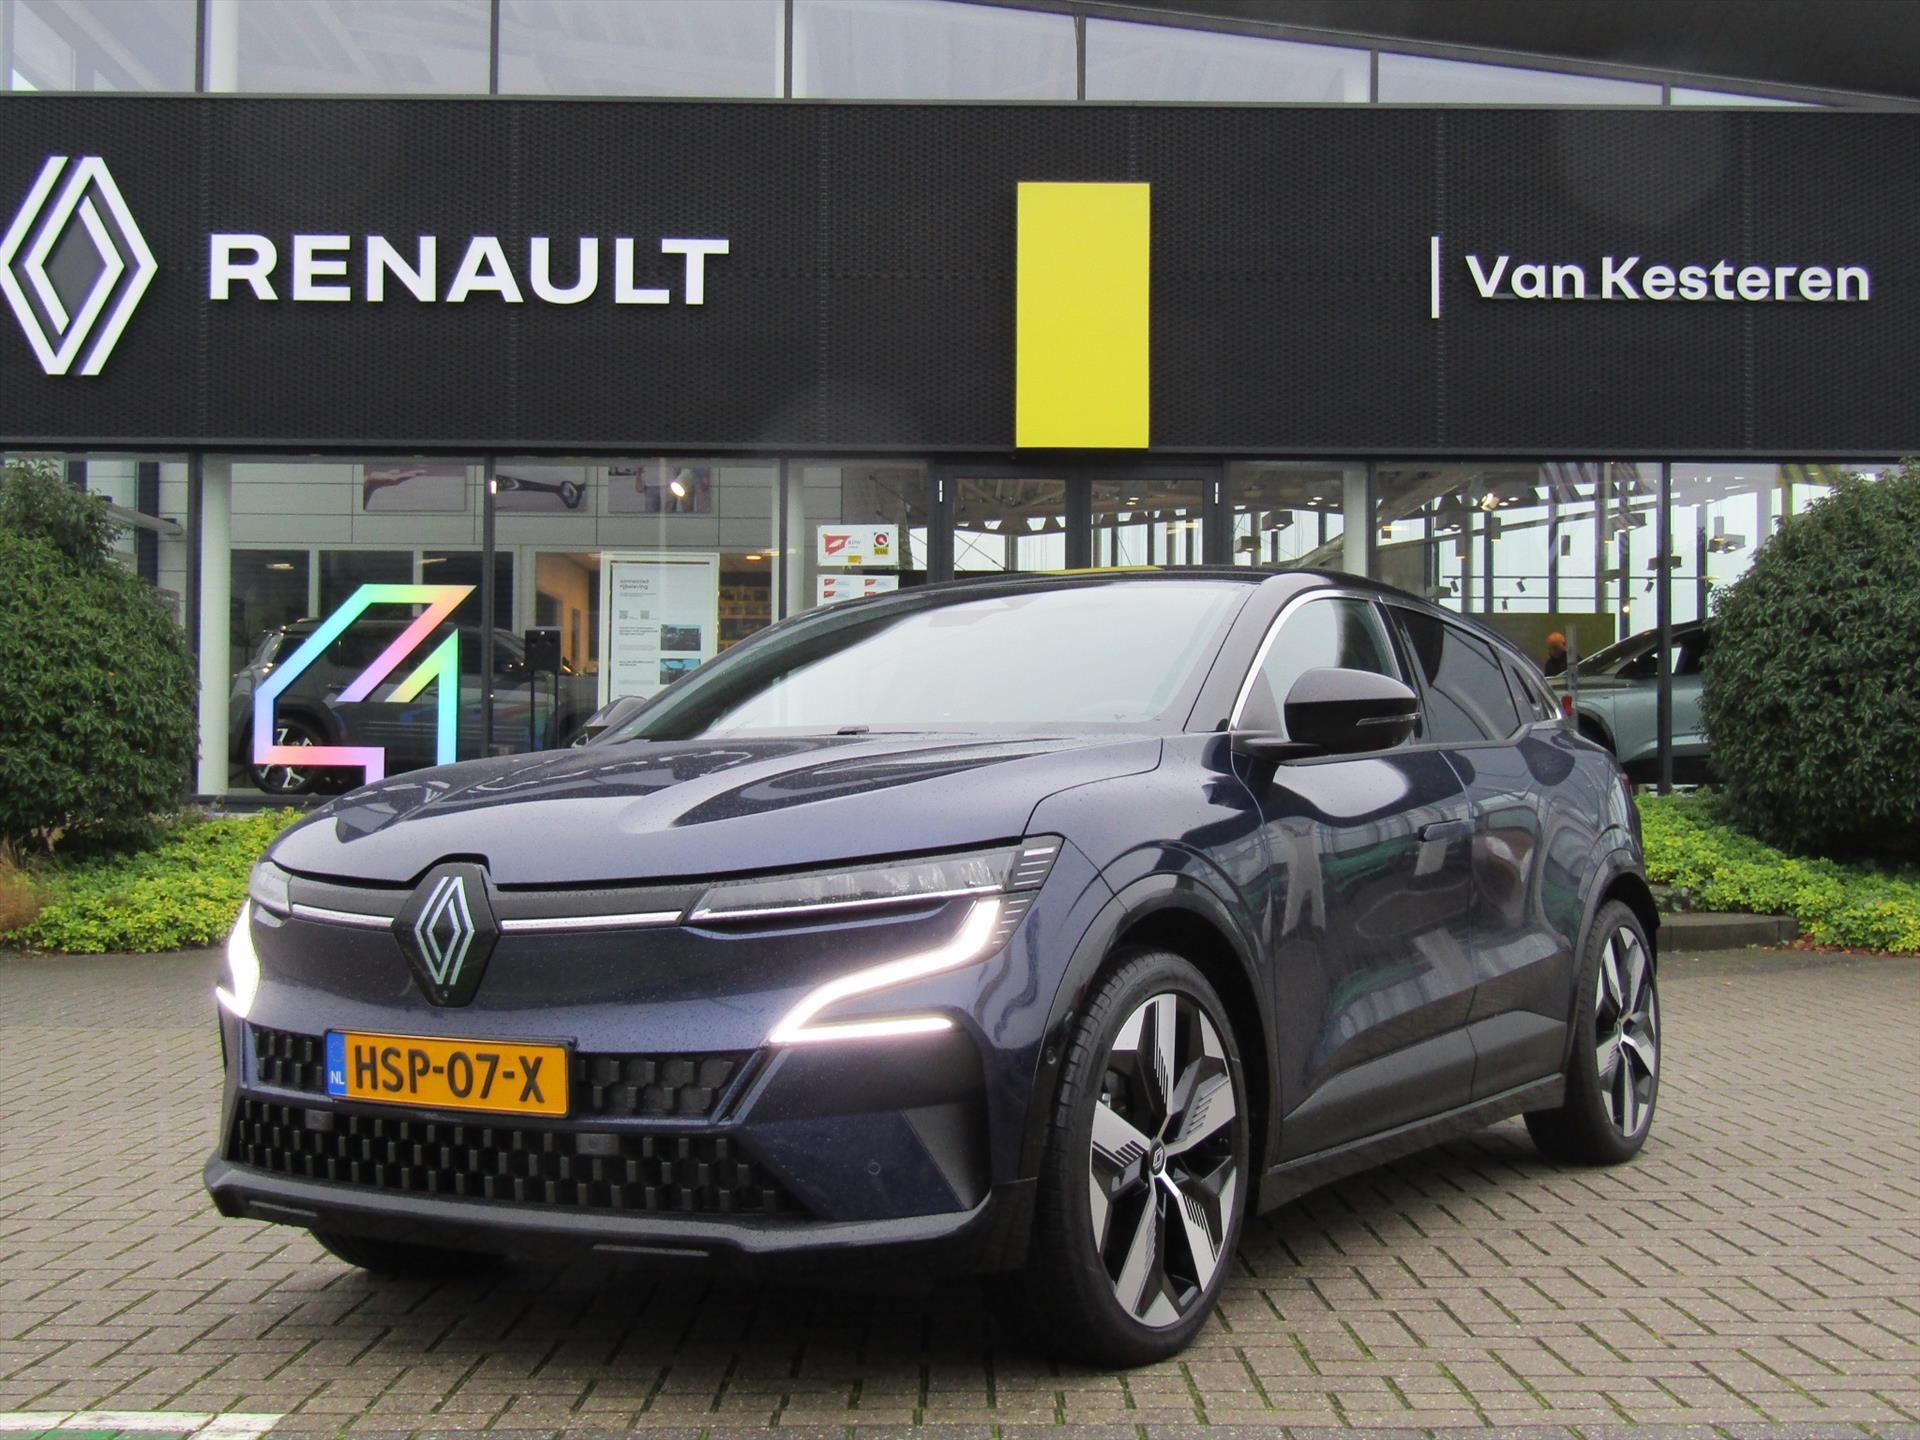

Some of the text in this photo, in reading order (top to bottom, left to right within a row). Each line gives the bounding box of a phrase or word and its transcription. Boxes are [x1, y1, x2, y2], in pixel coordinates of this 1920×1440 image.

[211, 234, 729, 304] RENAULT
[1466, 256, 1868, 300] Van Kesteren
[330, 1071, 345, 1085] NL
[354, 1045, 545, 1104] HSP-07-X
